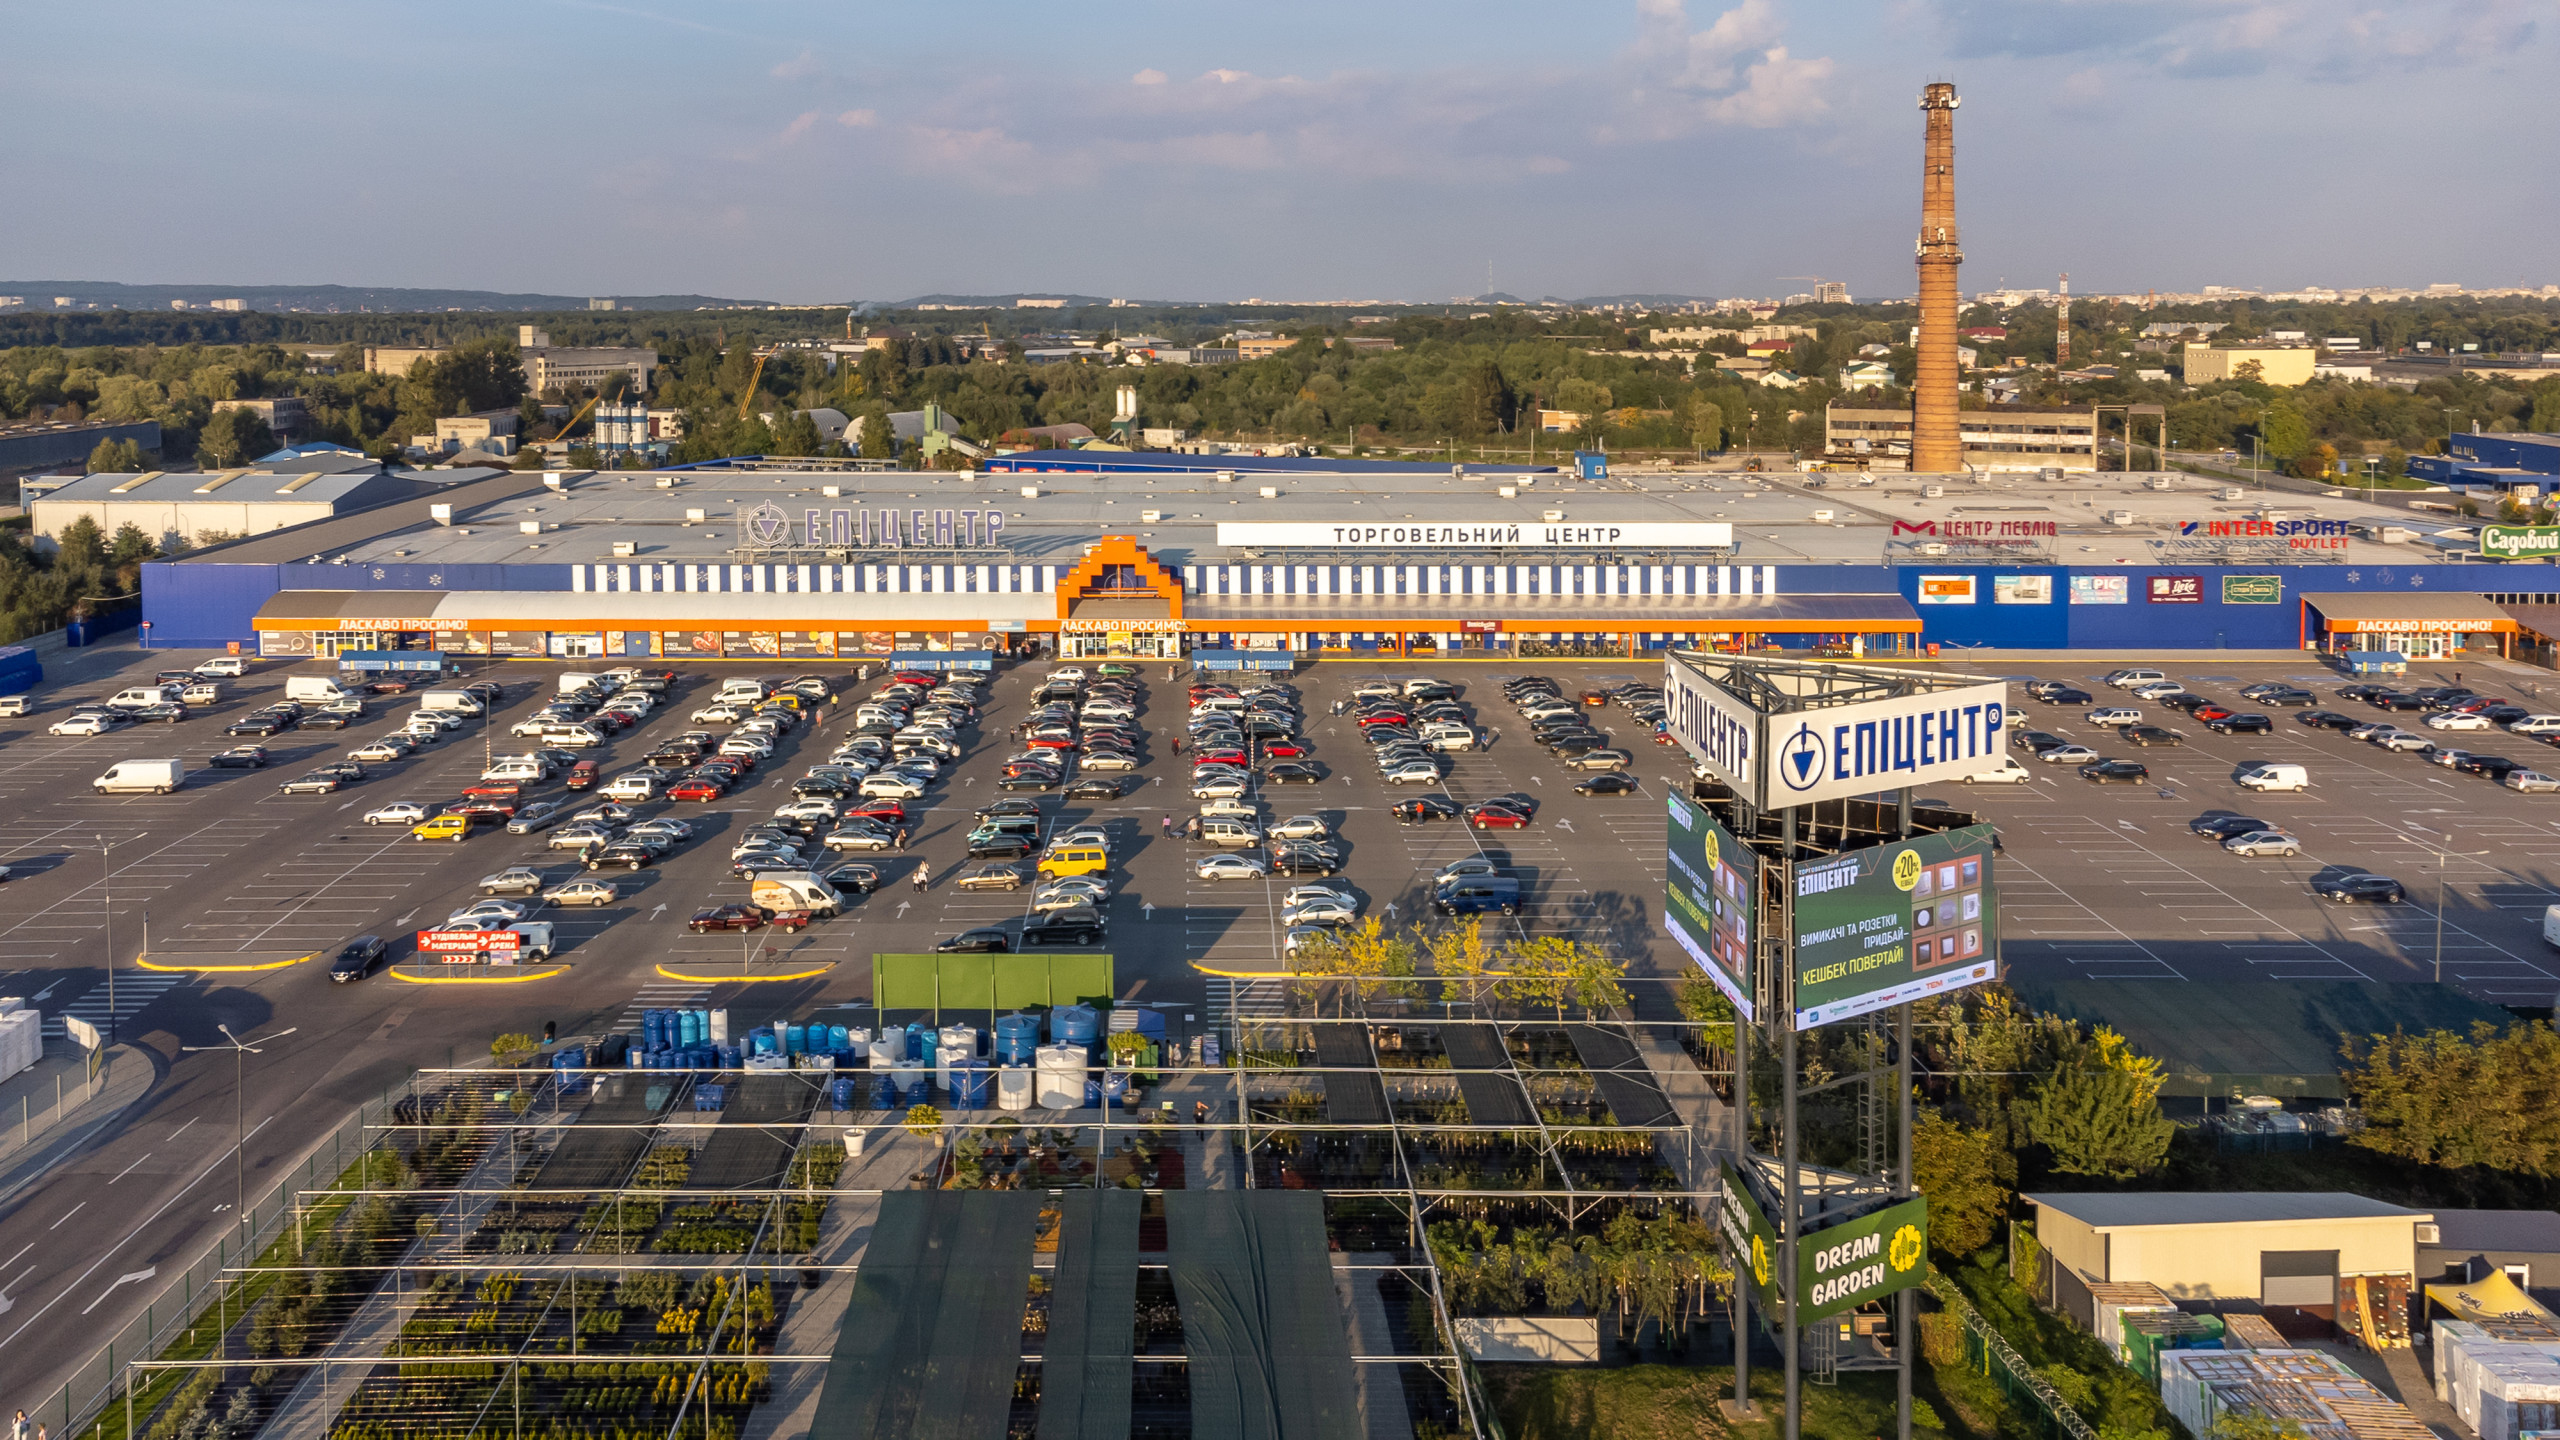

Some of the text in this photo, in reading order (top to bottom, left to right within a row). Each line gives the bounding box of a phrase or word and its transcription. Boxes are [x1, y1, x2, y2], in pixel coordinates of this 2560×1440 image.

[805, 508, 1004, 548] ЕПІЦЕНТР
[1334, 524, 1621, 544] ТОРГОВЕЛЬНИЙ ЦЕНТР
[1944, 520, 2057, 537] ЦЕНТР МЕБЛІВ
[2209, 520, 2350, 536] INTERSPORT
[2289, 538, 2350, 549] OUTLET
[339, 620, 468, 630] ЛАСКАВО ПРОСИМО!
[1061, 620, 1119, 631] ЛАСКАВО
[2356, 621, 2492, 631] ЛАСКАВО ПРОСИМО!
[1679, 683, 1751, 781] ЕПІЦЕНТР
[1834, 702, 2003, 781] ЕПІЦЕНТР
[1798, 865, 1859, 897] ЕПІЦЕНТР
[431, 933, 478, 941] БУДІВЕЛЬНІ
[489, 932, 516, 941] ДРАЙВ
[1800, 914, 1898, 947] ВИМИКАЧІ ТА РОЗЕТКИ
[431, 942, 478, 950] МАТЕРІАЛИ
[1803, 945, 1904, 986] КЕШБЕК ПОВЕРТАЙ!
[1721, 1177, 1749, 1233] DREAM
[1721, 1206, 1751, 1268] GARDEN
[1815, 1232, 1881, 1274] DREAM
[1811, 1262, 1885, 1307] GARDEN
